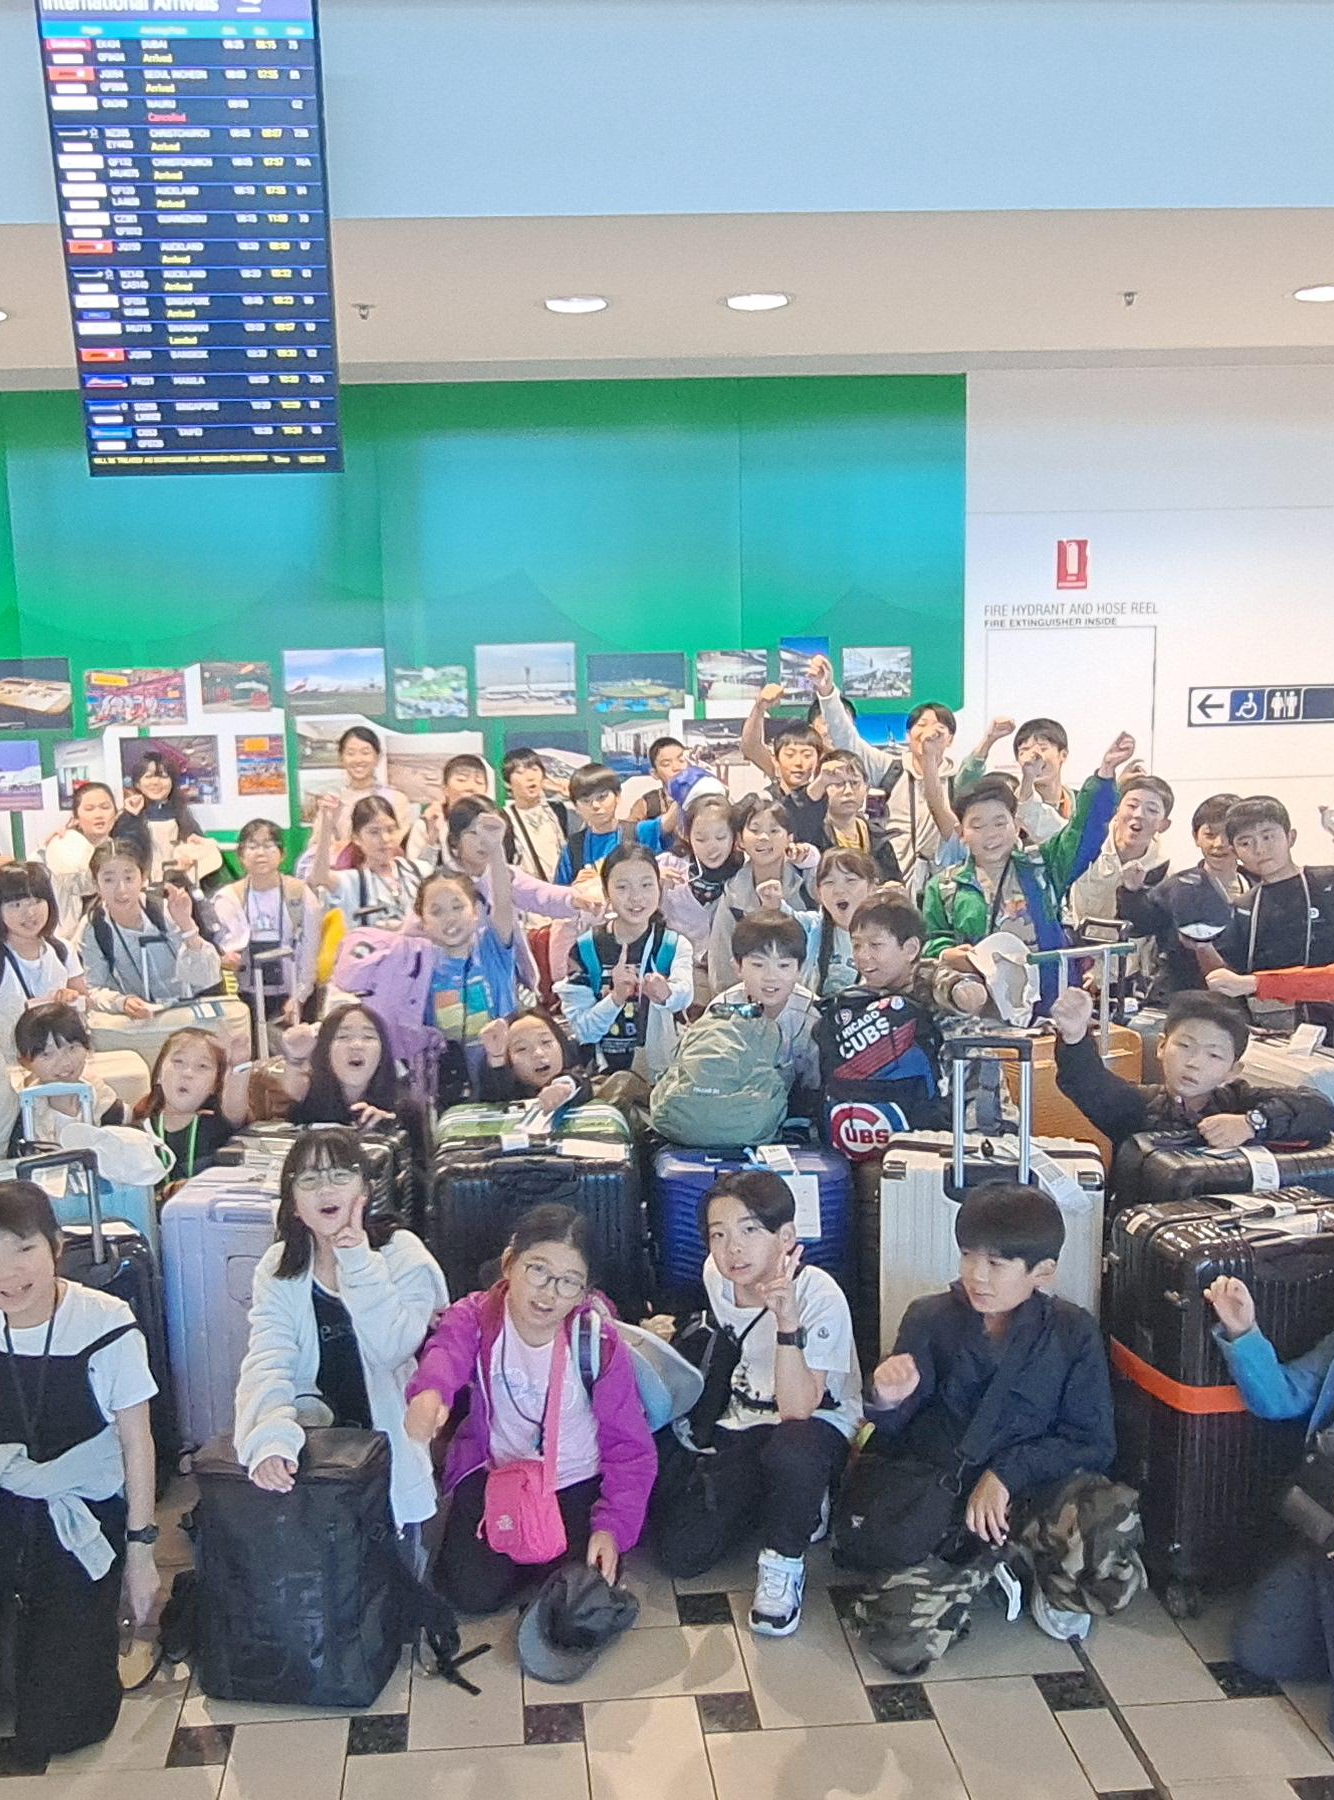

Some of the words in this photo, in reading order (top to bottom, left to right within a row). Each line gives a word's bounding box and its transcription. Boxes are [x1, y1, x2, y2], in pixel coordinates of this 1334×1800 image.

[984, 604, 1008, 617] FIRE
[1012, 603, 1066, 616] HYDRANT
[1069, 602, 1094, 615] AND
[1097, 602, 1127, 615] HOSE
[1131, 601, 1158, 614] REEL
[984, 619, 1006, 628] FIRE
[1009, 618, 1082, 628] EXTINGUISHER
[1085, 617, 1117, 626] INSIDE
[839, 1016, 890, 1060] CUBS
